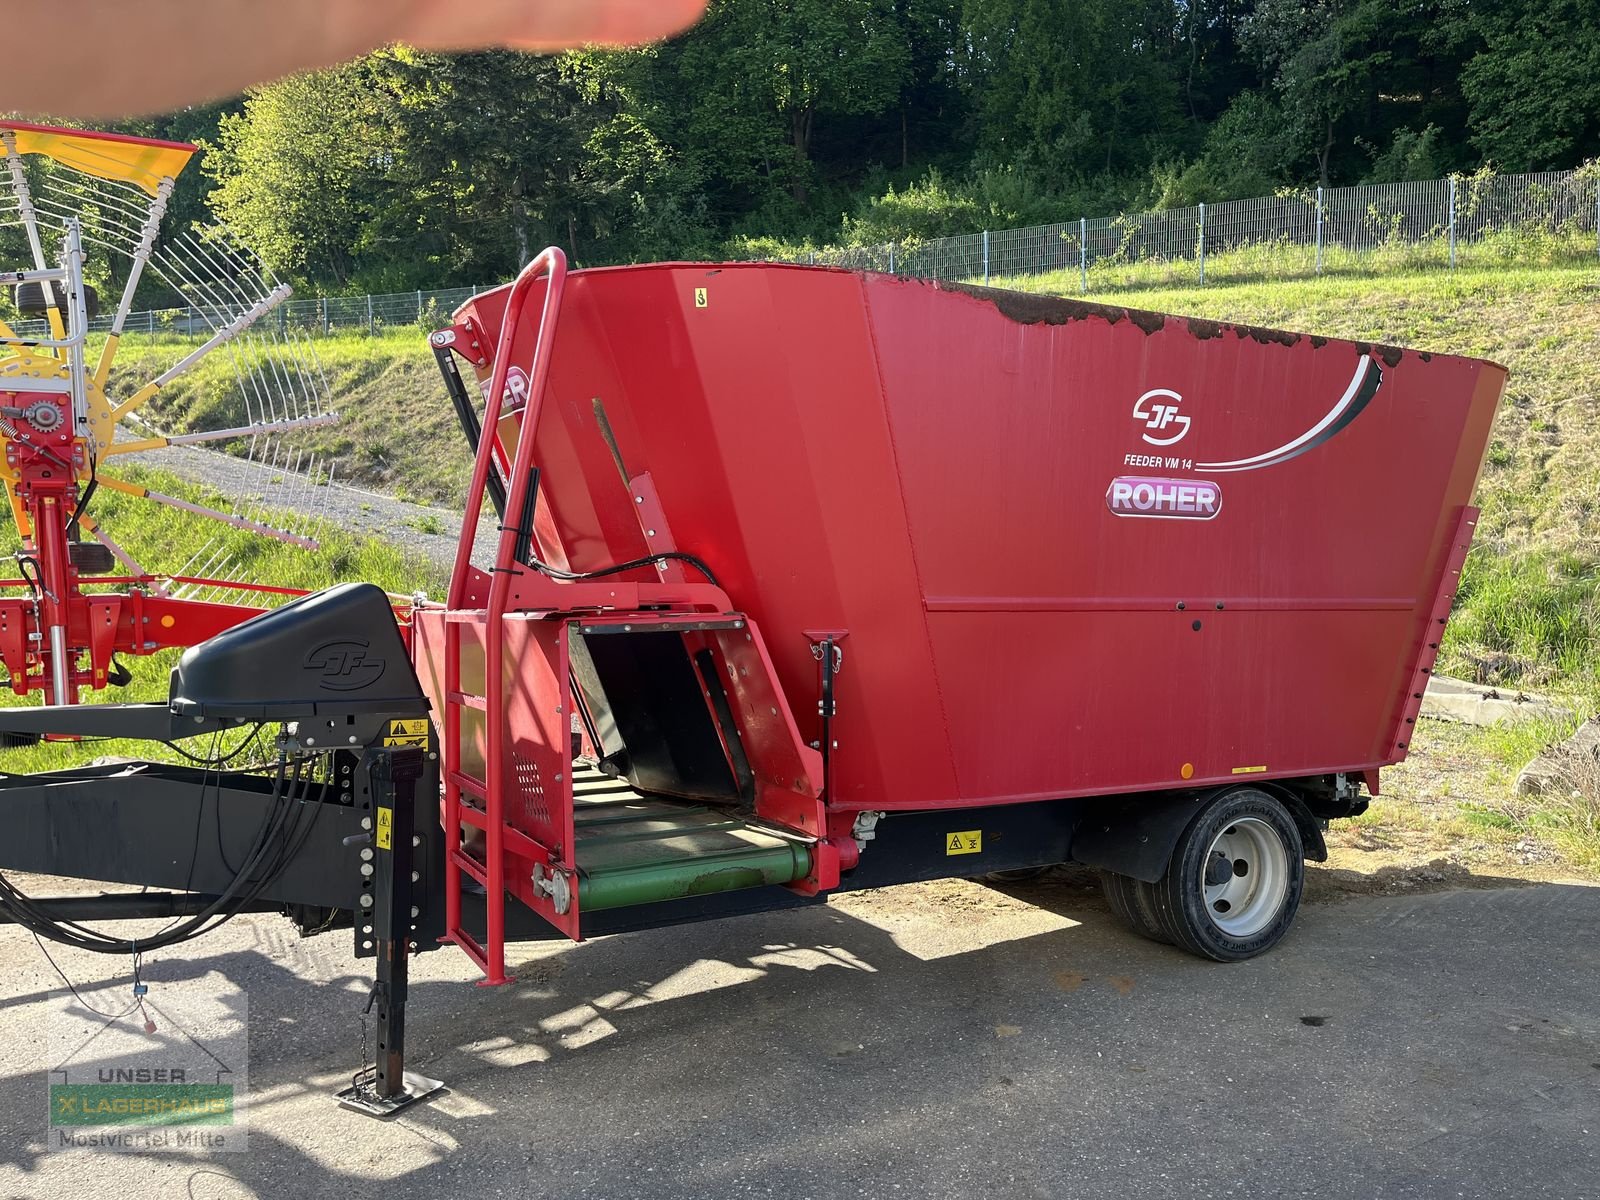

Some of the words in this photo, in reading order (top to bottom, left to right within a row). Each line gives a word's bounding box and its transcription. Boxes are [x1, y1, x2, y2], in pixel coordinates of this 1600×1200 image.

[1124, 454, 1162, 468] FEEDER
[1164, 457, 1179, 469] VM
[1182, 459, 1193, 470] 14
[1112, 483, 1216, 512] ROHER
